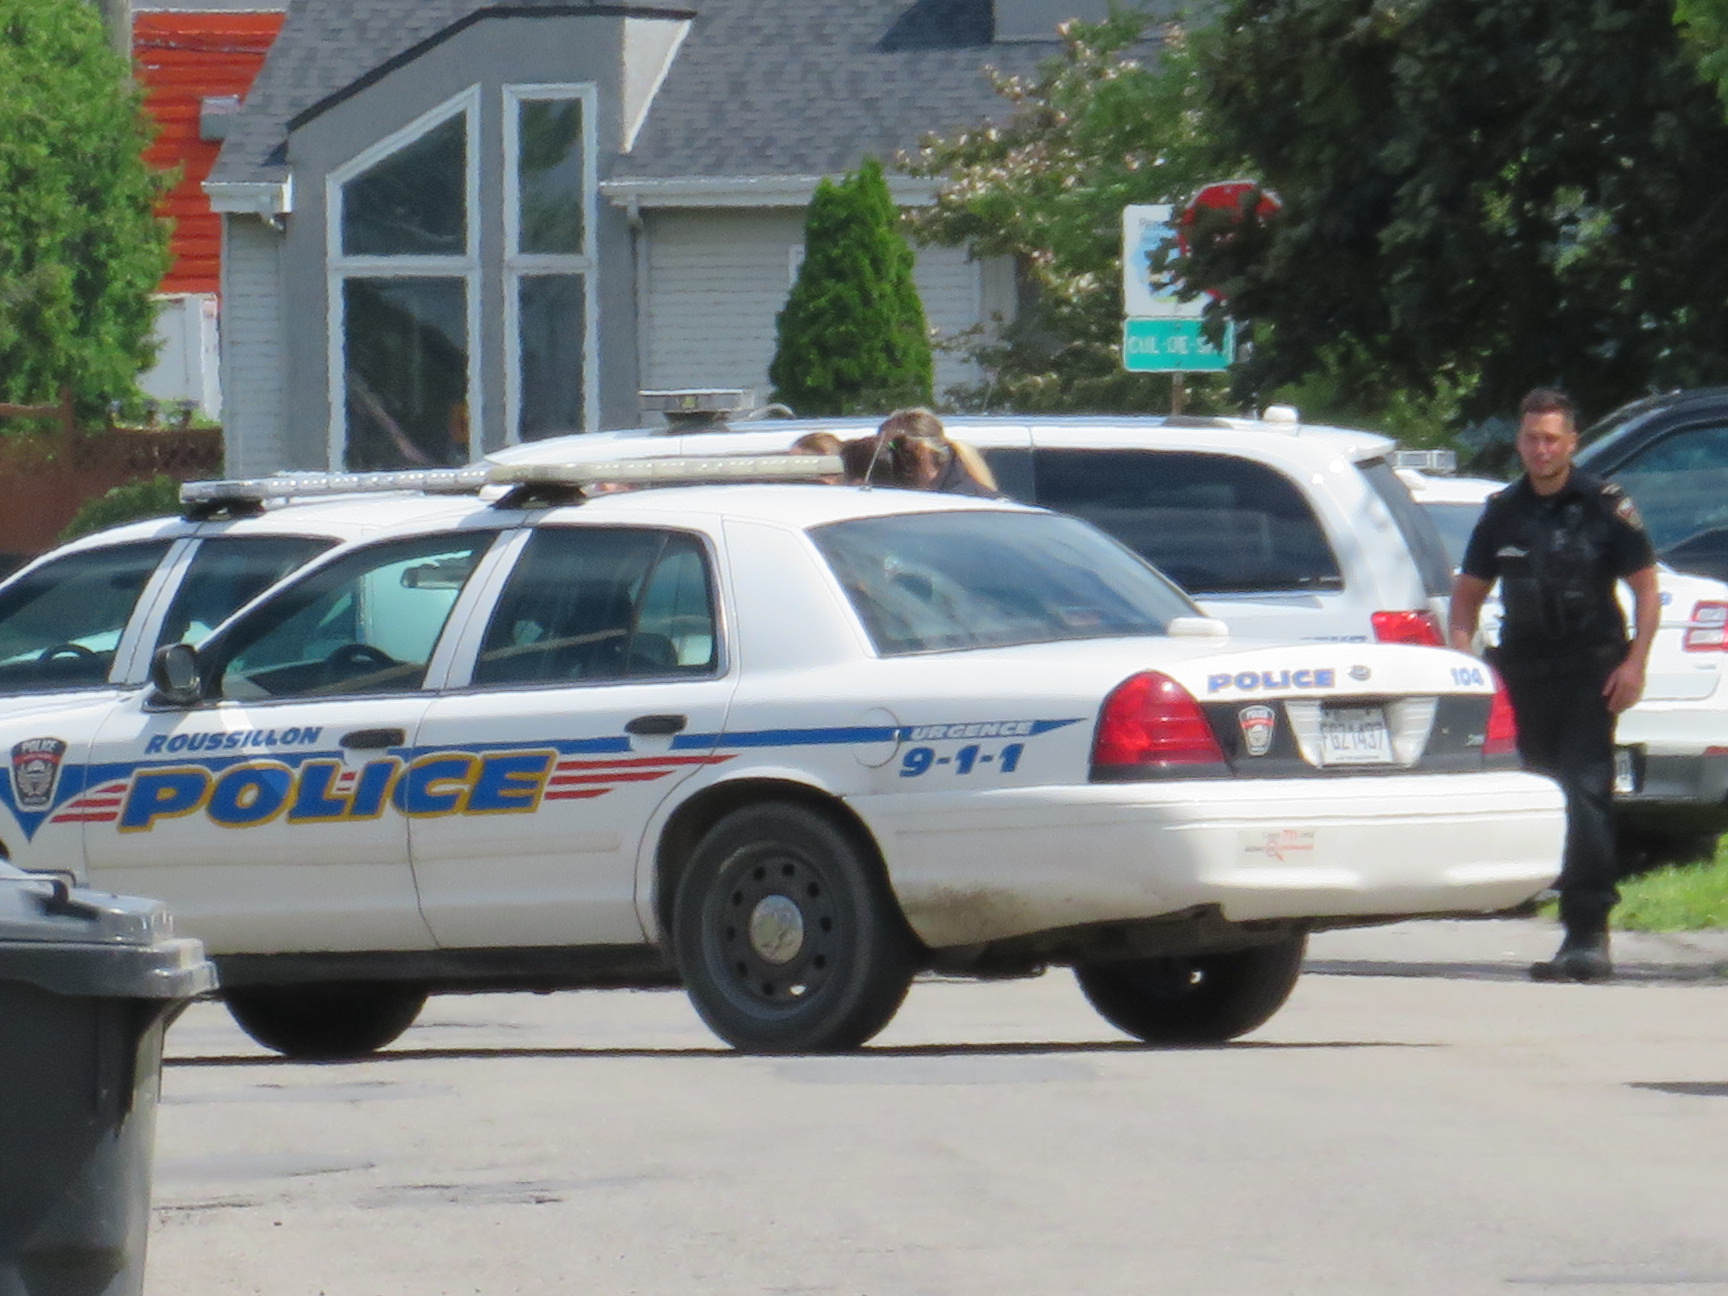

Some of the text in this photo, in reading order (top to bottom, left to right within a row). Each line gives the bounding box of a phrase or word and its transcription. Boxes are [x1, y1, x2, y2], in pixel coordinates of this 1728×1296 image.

[1207, 667, 1337, 693] POLICE
[1450, 666, 1485, 687] 104
[146, 726, 324, 754] ROUSSILLON
[910, 721, 1034, 741] URGENCE
[899, 743, 1024, 778] 9-1-1
[117, 747, 558, 833] POLICE
